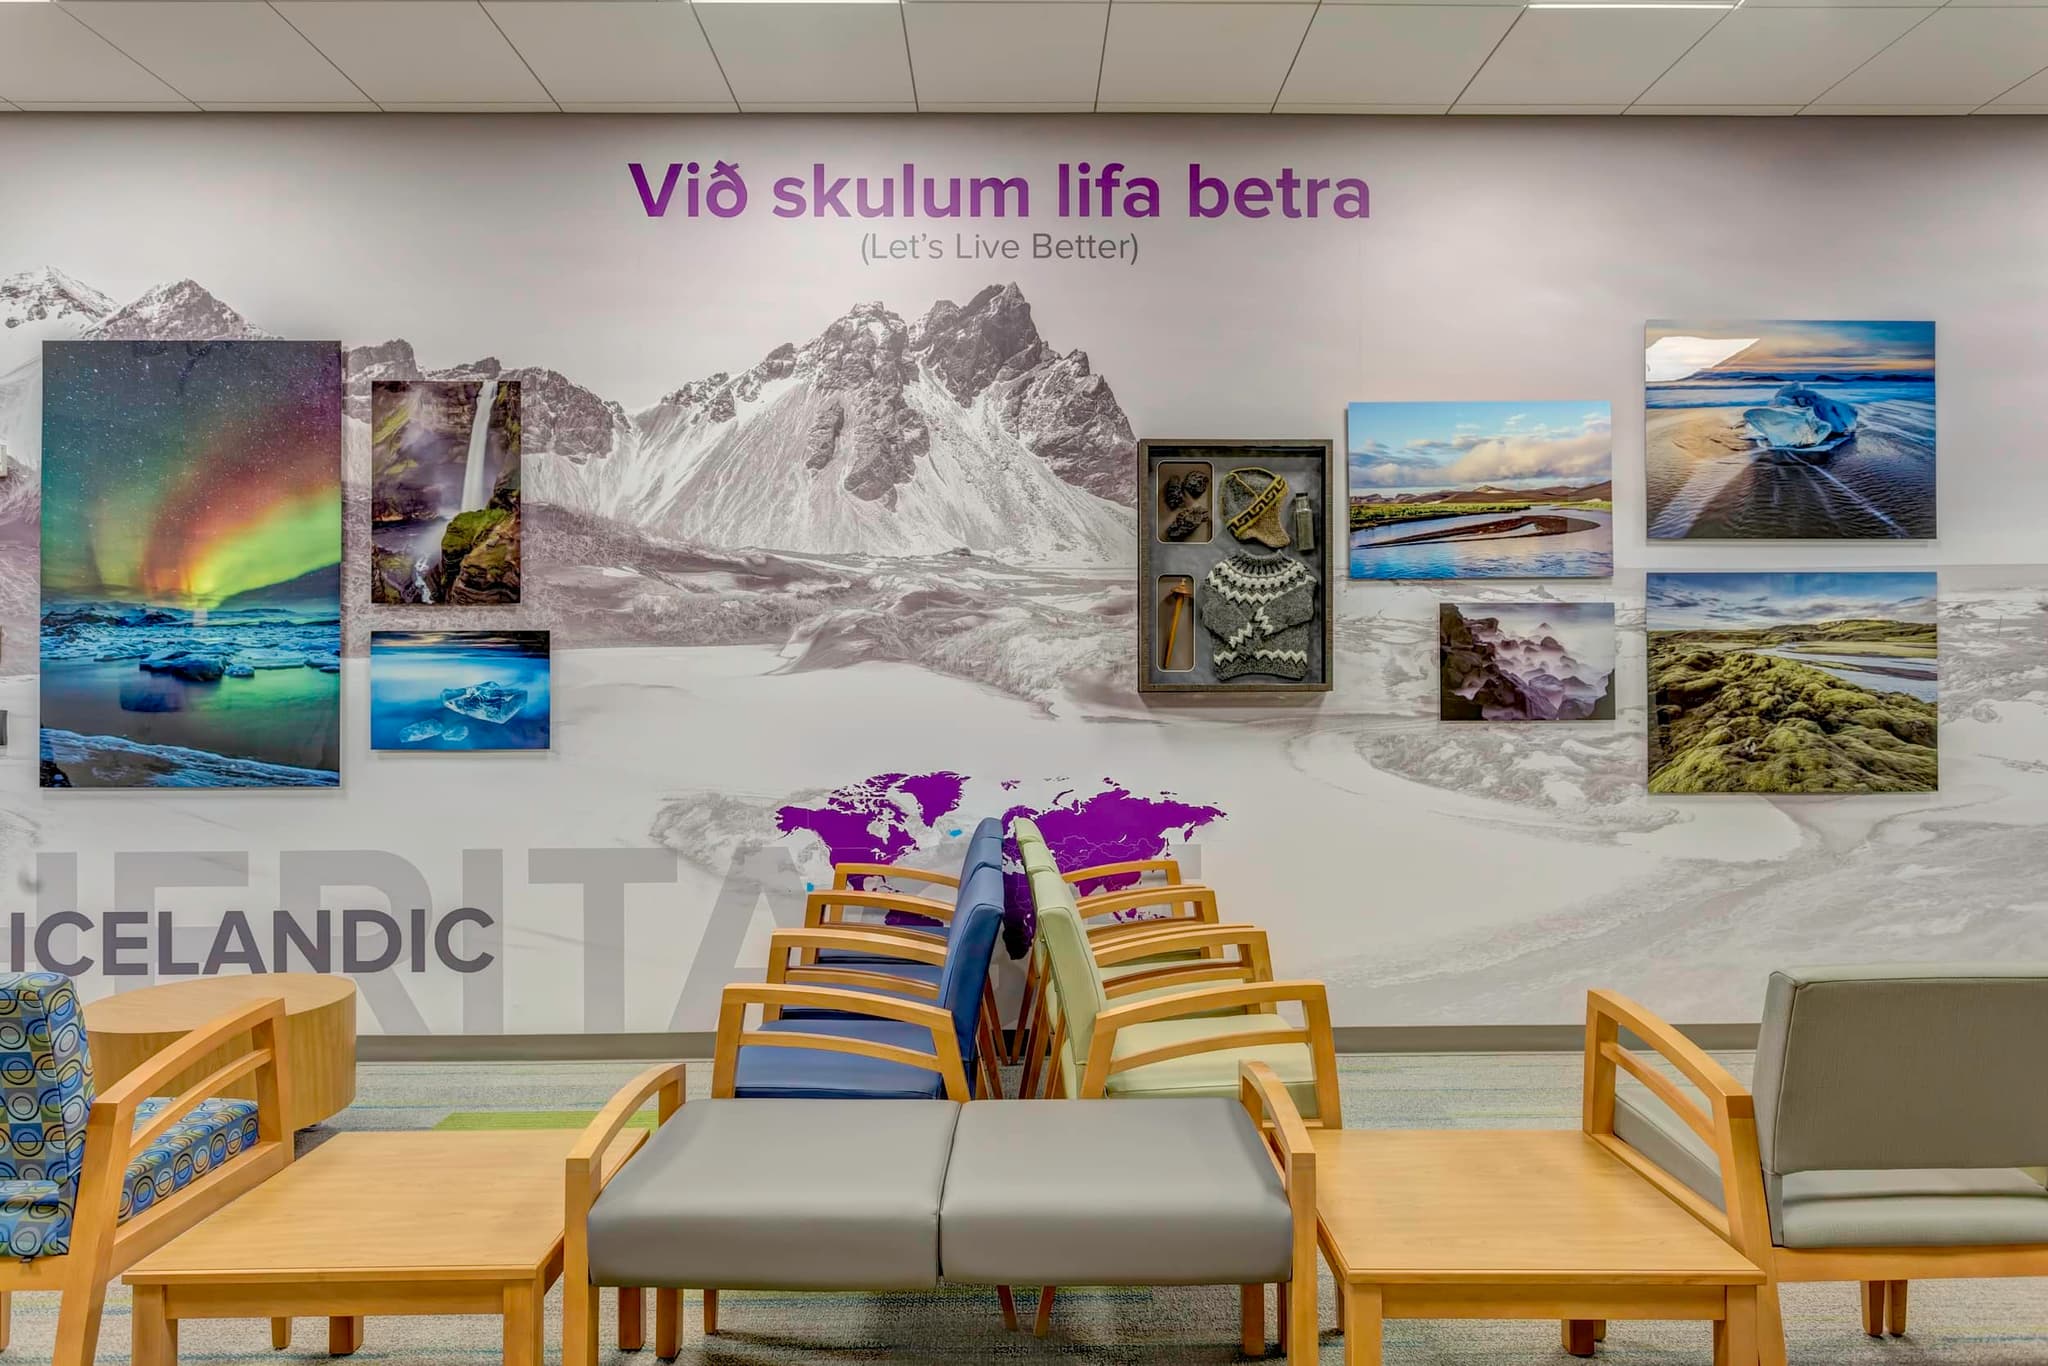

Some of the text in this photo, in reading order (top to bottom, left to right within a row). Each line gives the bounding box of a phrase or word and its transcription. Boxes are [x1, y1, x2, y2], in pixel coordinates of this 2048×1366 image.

[628, 160, 1371, 219] Við skulum lifa betra
[860, 232, 1139, 265] (Let’s Live Better)
[11, 907, 496, 976] ICELANDIC
